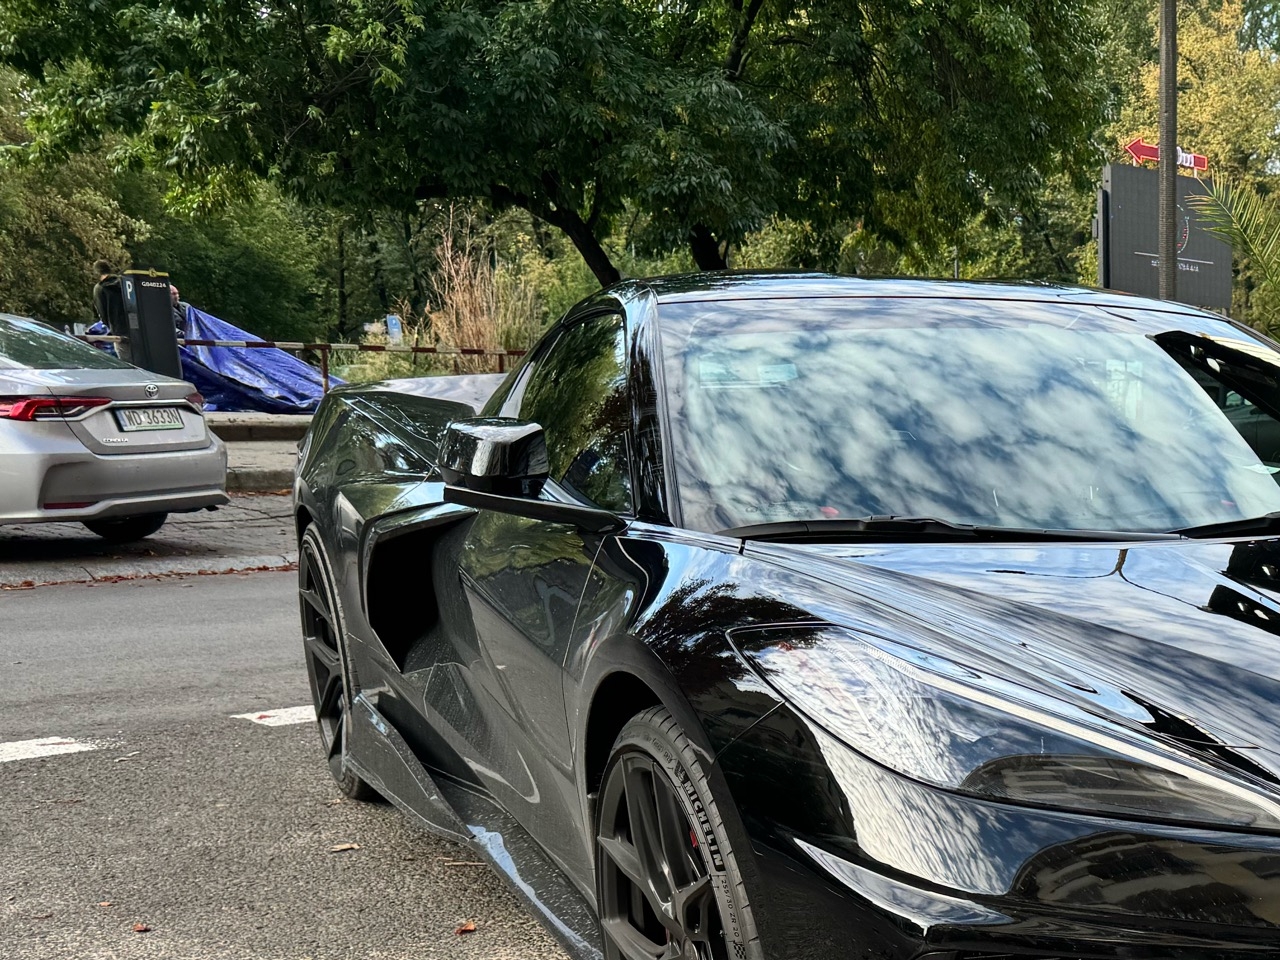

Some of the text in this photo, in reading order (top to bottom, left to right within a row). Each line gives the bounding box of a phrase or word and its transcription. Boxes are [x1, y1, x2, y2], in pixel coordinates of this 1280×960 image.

[123, 410, 143, 426] WD
[683, 779, 724, 867] MICHELIN
[721, 879, 740, 938] 255/30 ZR 20
